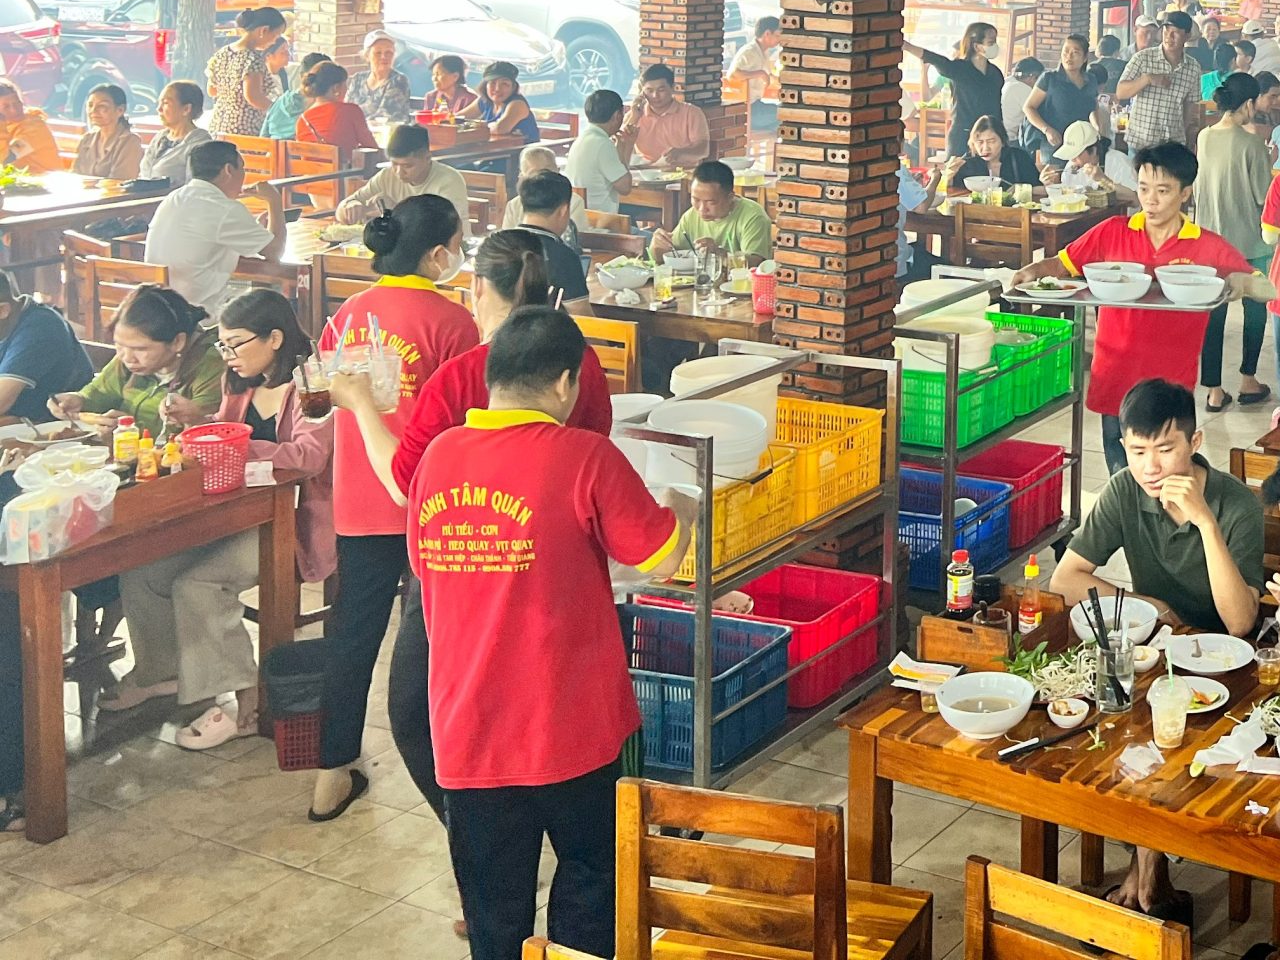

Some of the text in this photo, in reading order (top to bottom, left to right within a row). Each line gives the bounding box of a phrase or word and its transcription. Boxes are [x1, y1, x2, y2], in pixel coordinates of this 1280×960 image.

[387, 334, 421, 365] QUÁN
[450, 481, 487, 507] TÂM
[491, 490, 533, 526] QUÁN
[467, 540, 489, 553] QUAY
[511, 539, 534, 552] QUAY
